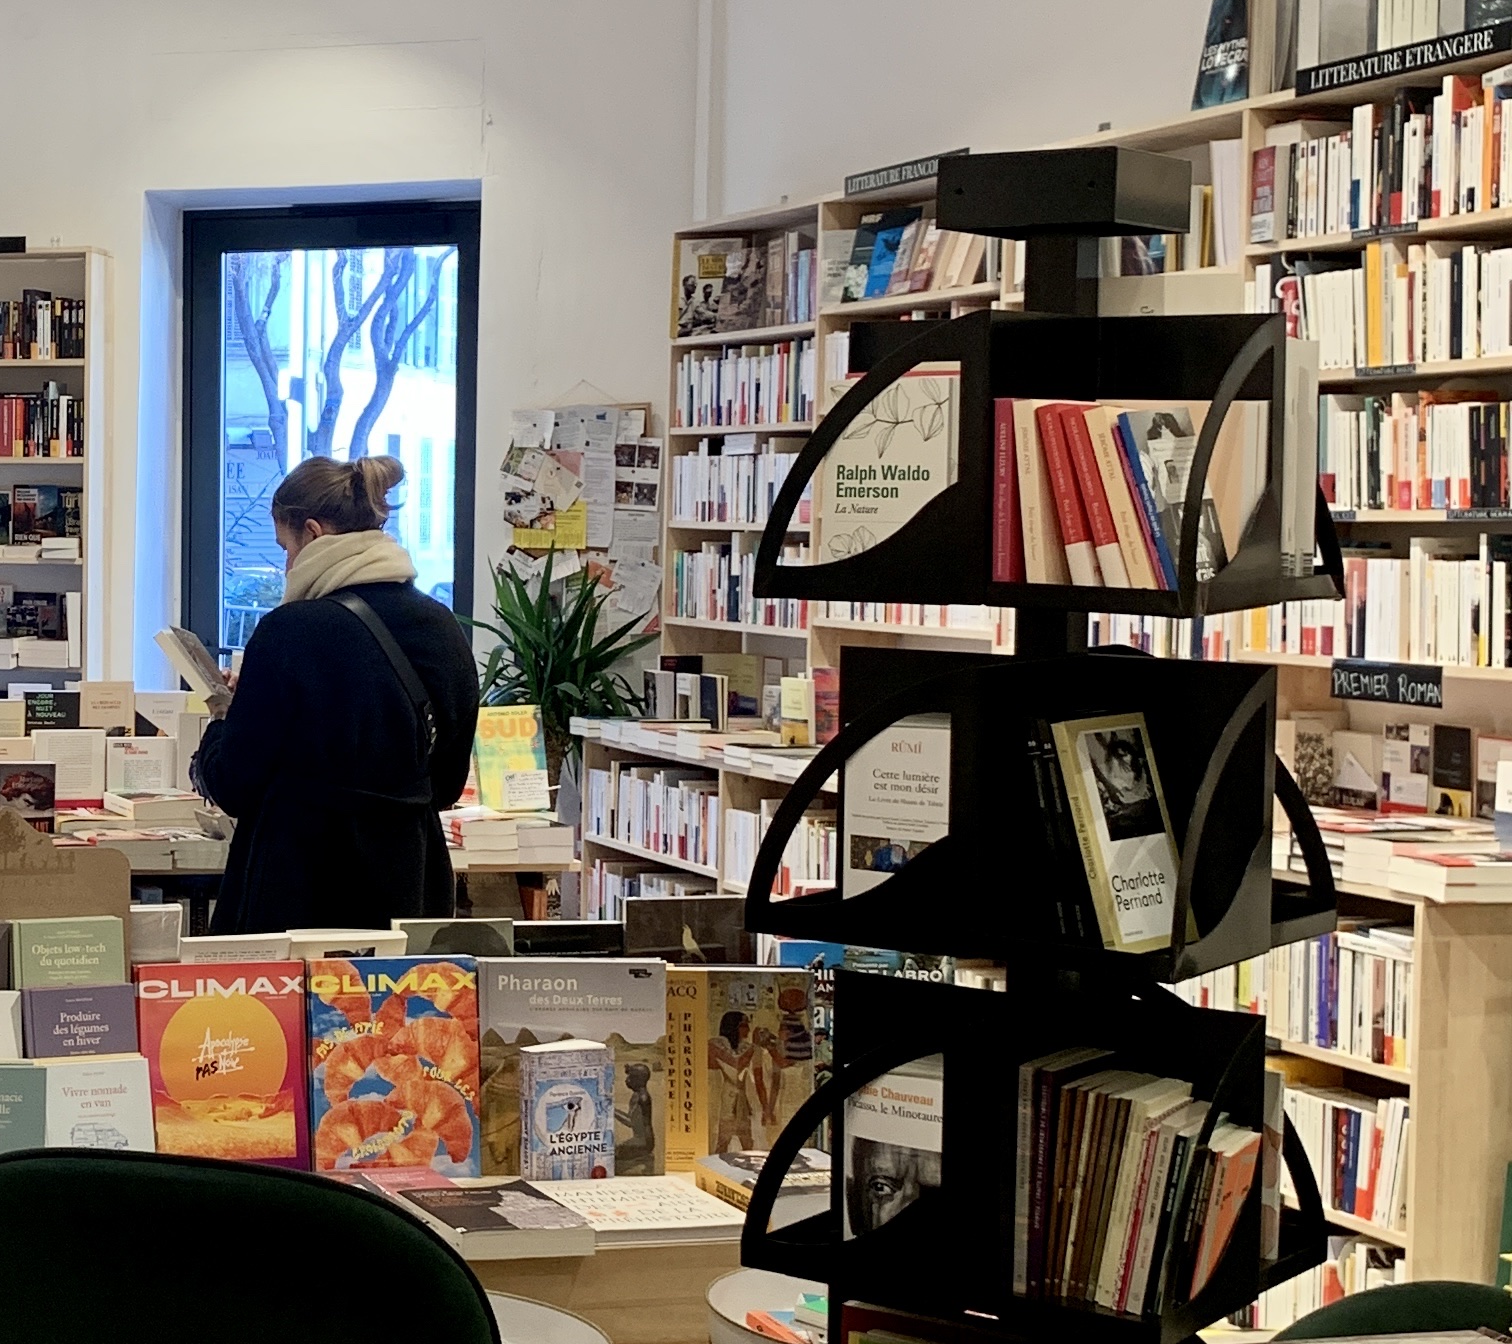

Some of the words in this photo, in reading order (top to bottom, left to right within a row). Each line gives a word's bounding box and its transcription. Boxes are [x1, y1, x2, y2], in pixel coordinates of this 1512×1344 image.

[1310, 49, 1402, 90] LITTERATURE
[1404, 29, 1494, 69] ETRANGERE
[847, 164, 901, 194] LITTERATURE
[836, 464, 877, 485] Ralph
[881, 465, 930, 481] Waldo
[836, 482, 899, 498] Emerson
[835, 503, 846, 514] La
[848, 503, 879, 514] Nature
[1333, 668, 1389, 698] PREMIER
[1397, 673, 1441, 704] ROMAN
[479, 718, 538, 739] SUD
[872, 768, 900, 780] Cette
[902, 770, 941, 784] lumière
[873, 782, 887, 791] est
[890, 783, 912, 793] mon
[914, 783, 939, 795] désir
[1072, 796, 1087, 834] Perriand
[1080, 835, 1096, 879] Charlotte
[1111, 869, 1166, 893] Charlotte
[1115, 888, 1163, 912] Perriand
[31, 944, 63, 958] Objets
[64, 943, 106, 955] low-tech
[39, 956, 52, 966] du
[54, 955, 100, 968] quotidien
[138, 975, 305, 1000] CLIMAX
[309, 971, 477, 995] CLIMAX
[497, 973, 578, 992] Pharaon
[666, 985, 697, 1000] ACQ
[529, 994, 550, 1006] des
[552, 994, 585, 1006] Deux
[586, 994, 623, 1006] Terres
[60, 1011, 101, 1023] Produire
[53, 1024, 69, 1036] des
[71, 1023, 110, 1037] légumes
[63, 1038, 75, 1046] en
[76, 1036, 101, 1046] hiver
[199, 1027, 251, 1062] Apocalypse
[195, 1060, 219, 1081] PAS
[61, 1086, 89, 1097] Vivre
[90, 1084, 128, 1095] nomade
[453, 1077, 476, 1102] LES
[881, 1086, 934, 1107] Chauveau
[80, 1100, 93, 1109] en
[94, 1098, 111, 1108] van
[880, 1102, 889, 1114] le
[890, 1105, 944, 1124] Minotaure
[549, 1130, 601, 1145] L'ÉGYPTE
[549, 1141, 608, 1157] ANCIENNE
